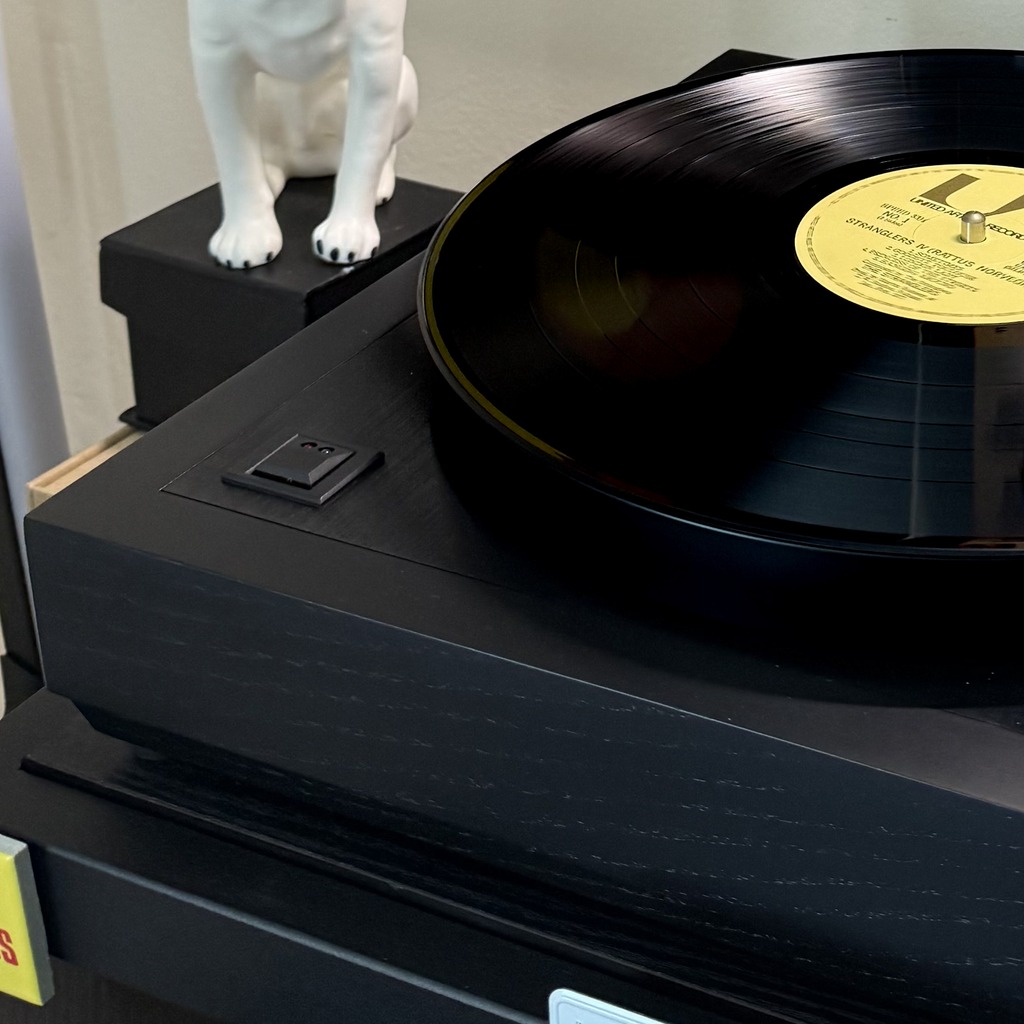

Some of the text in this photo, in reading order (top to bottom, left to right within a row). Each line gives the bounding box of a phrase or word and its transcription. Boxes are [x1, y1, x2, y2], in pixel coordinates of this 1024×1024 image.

[909, 197, 947, 213] UNITED
[845, 217, 916, 246] STRANGLERS
[915, 243, 930, 252] IV
[926, 244, 977, 268] (RATTUS
